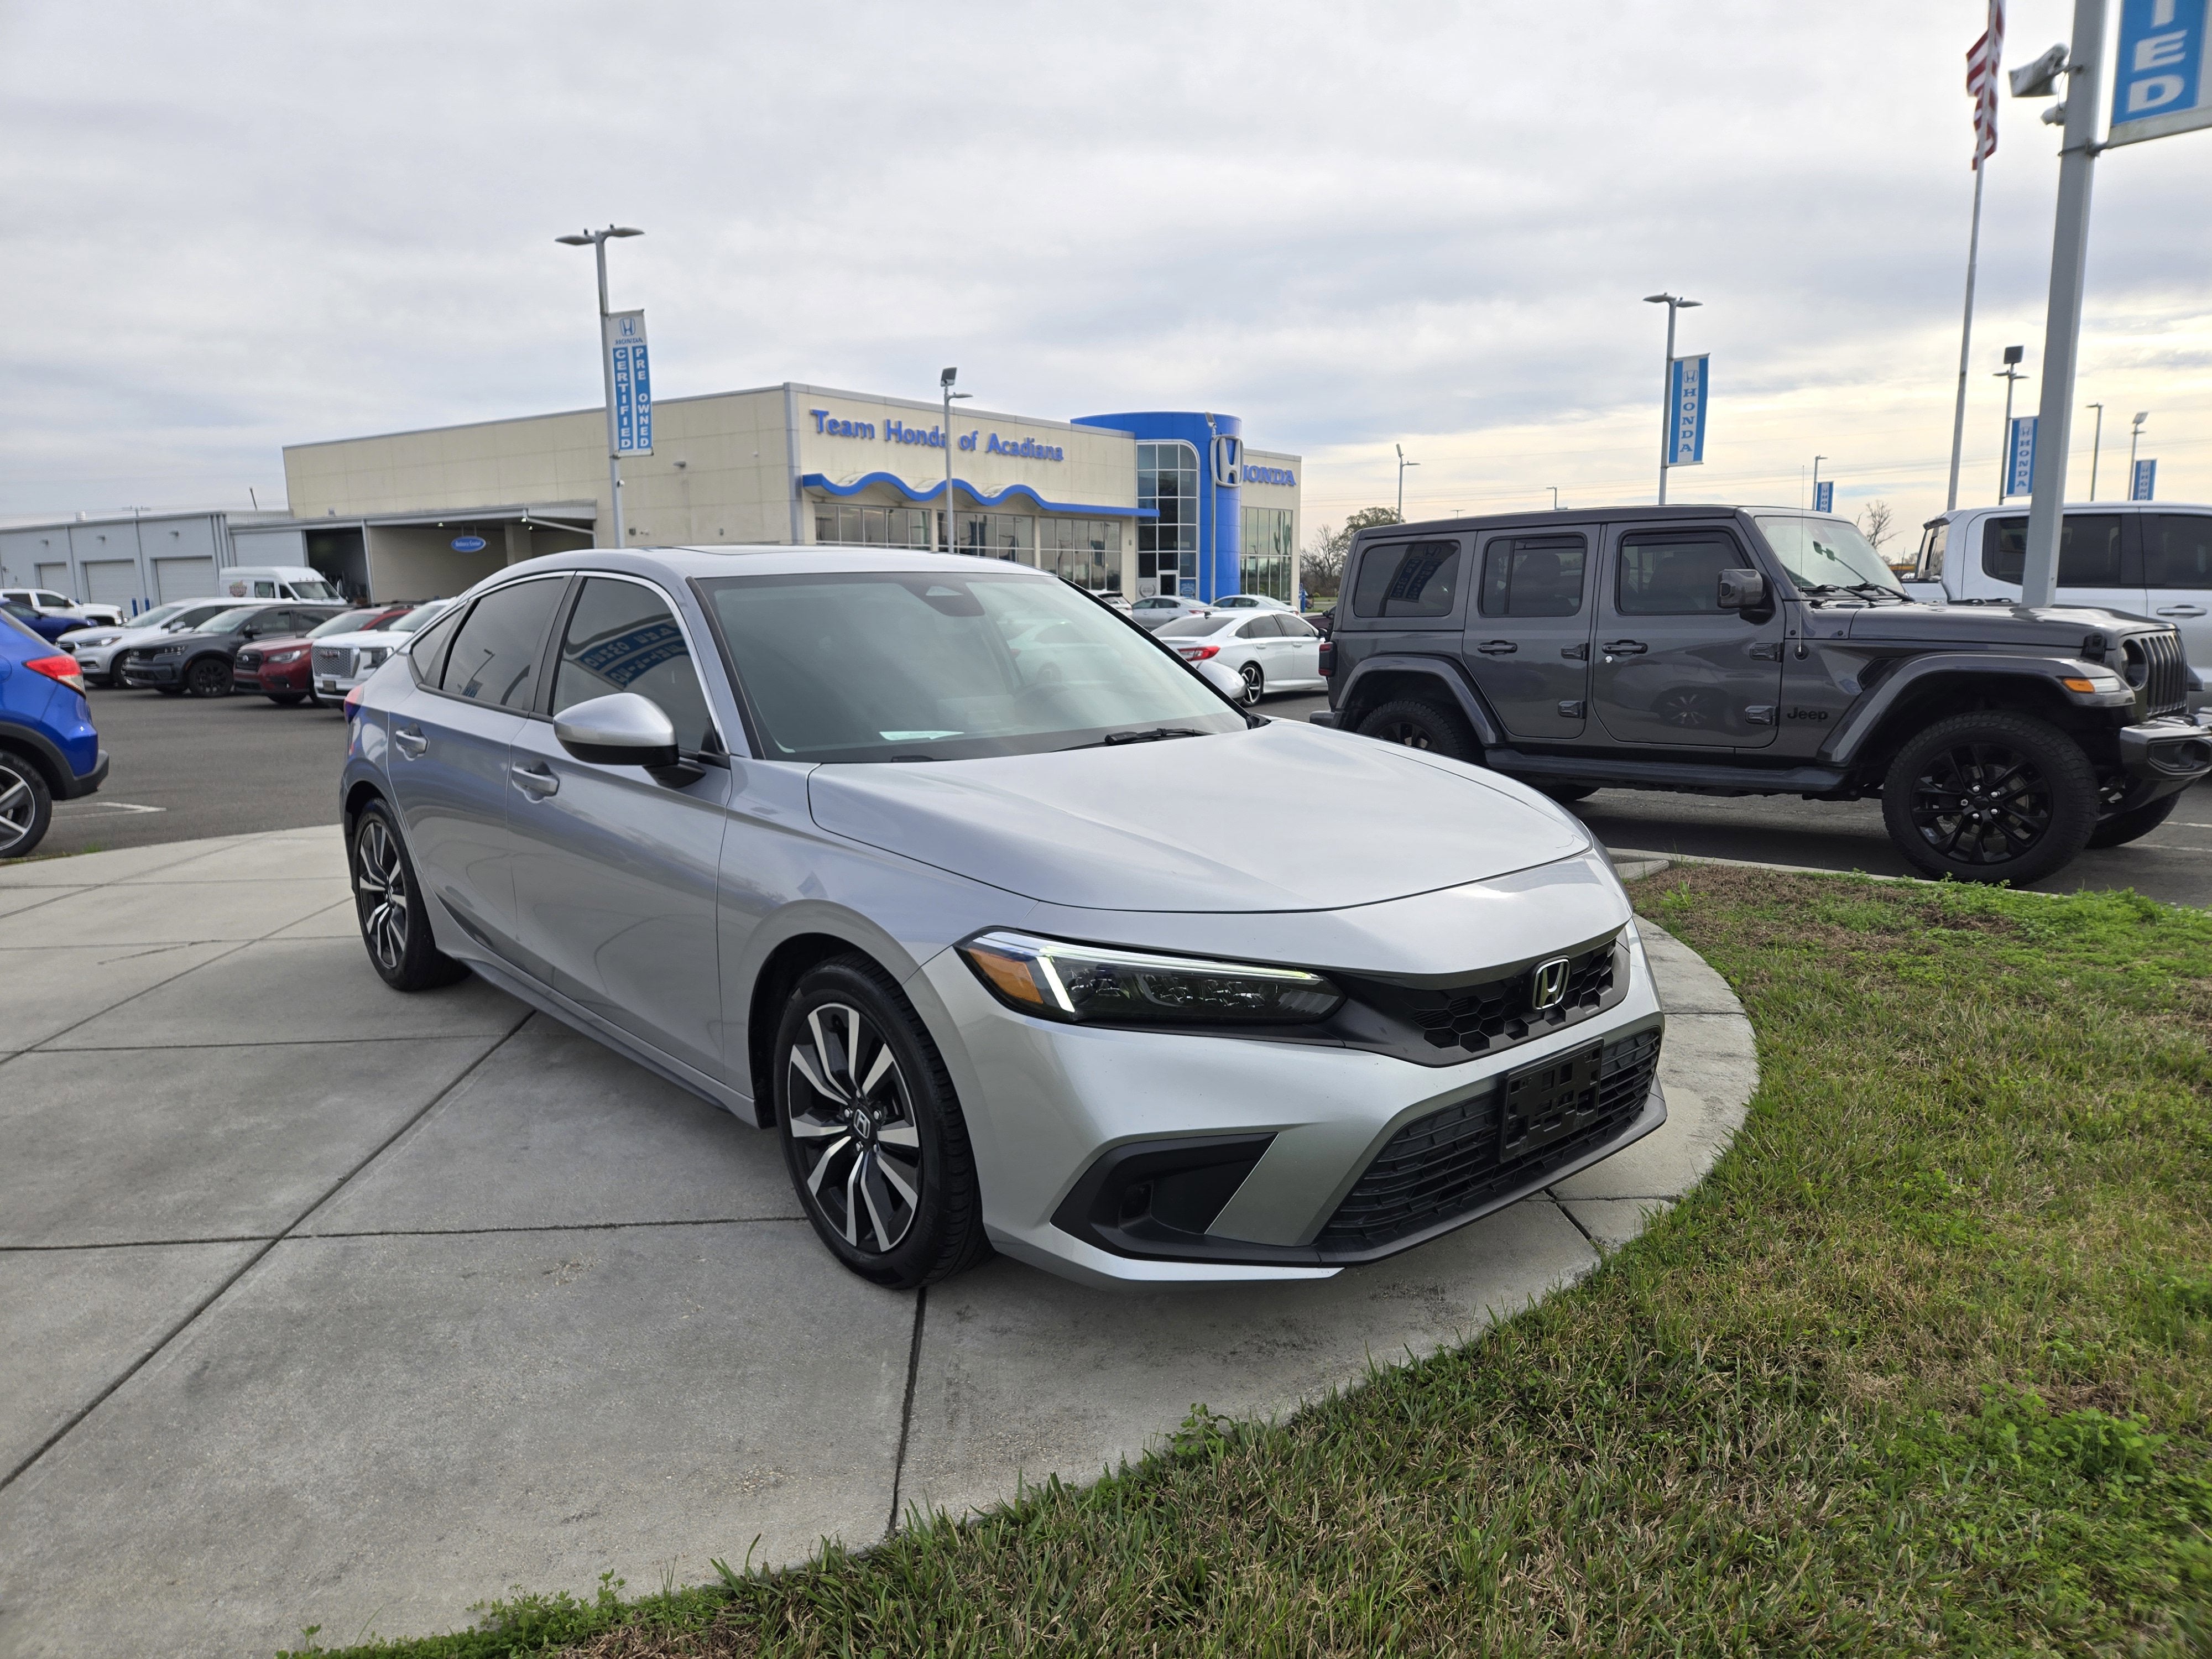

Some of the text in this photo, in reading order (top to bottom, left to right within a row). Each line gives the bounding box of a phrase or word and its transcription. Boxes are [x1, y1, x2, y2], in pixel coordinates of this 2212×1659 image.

[615, 349, 632, 448] CERTIFIED
[636, 348, 650, 447] PRE OWNED
[1679, 388, 1697, 452] HONDA
[810, 409, 875, 439] Team
[959, 430, 979, 451] of
[985, 433, 1064, 461] Acadiana
[2016, 439, 2031, 487] HONDA
[1787, 707, 1828, 722] Jeep
